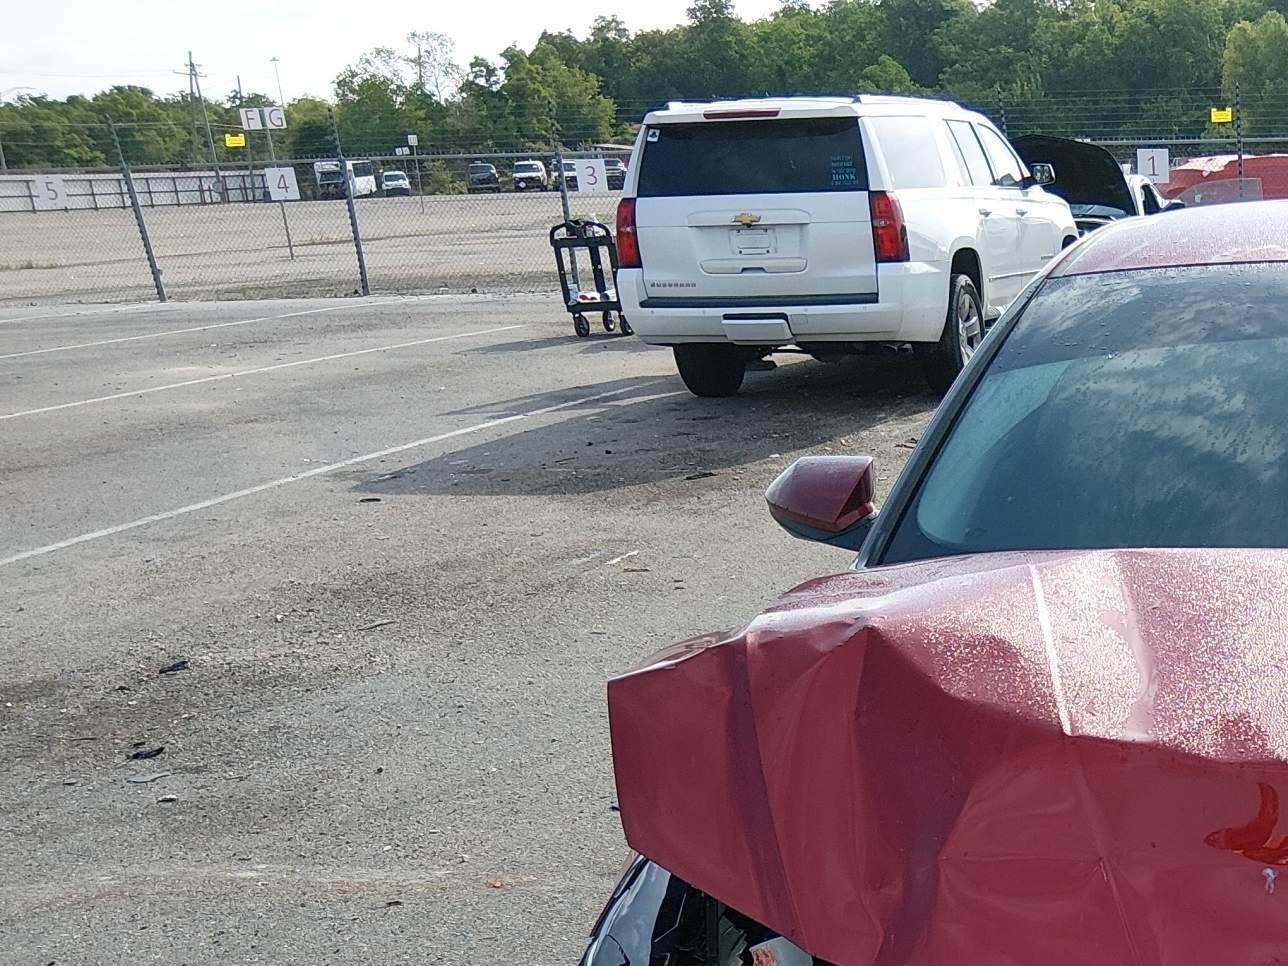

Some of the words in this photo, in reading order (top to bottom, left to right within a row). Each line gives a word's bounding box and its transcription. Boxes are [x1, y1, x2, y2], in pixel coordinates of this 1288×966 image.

[244, 109, 256, 129] F
[268, 108, 284, 128] G
[584, 165, 598, 186] 3
[1147, 155, 1160, 177] 1
[44, 181, 58, 201] 5
[276, 174, 290, 194] 4
